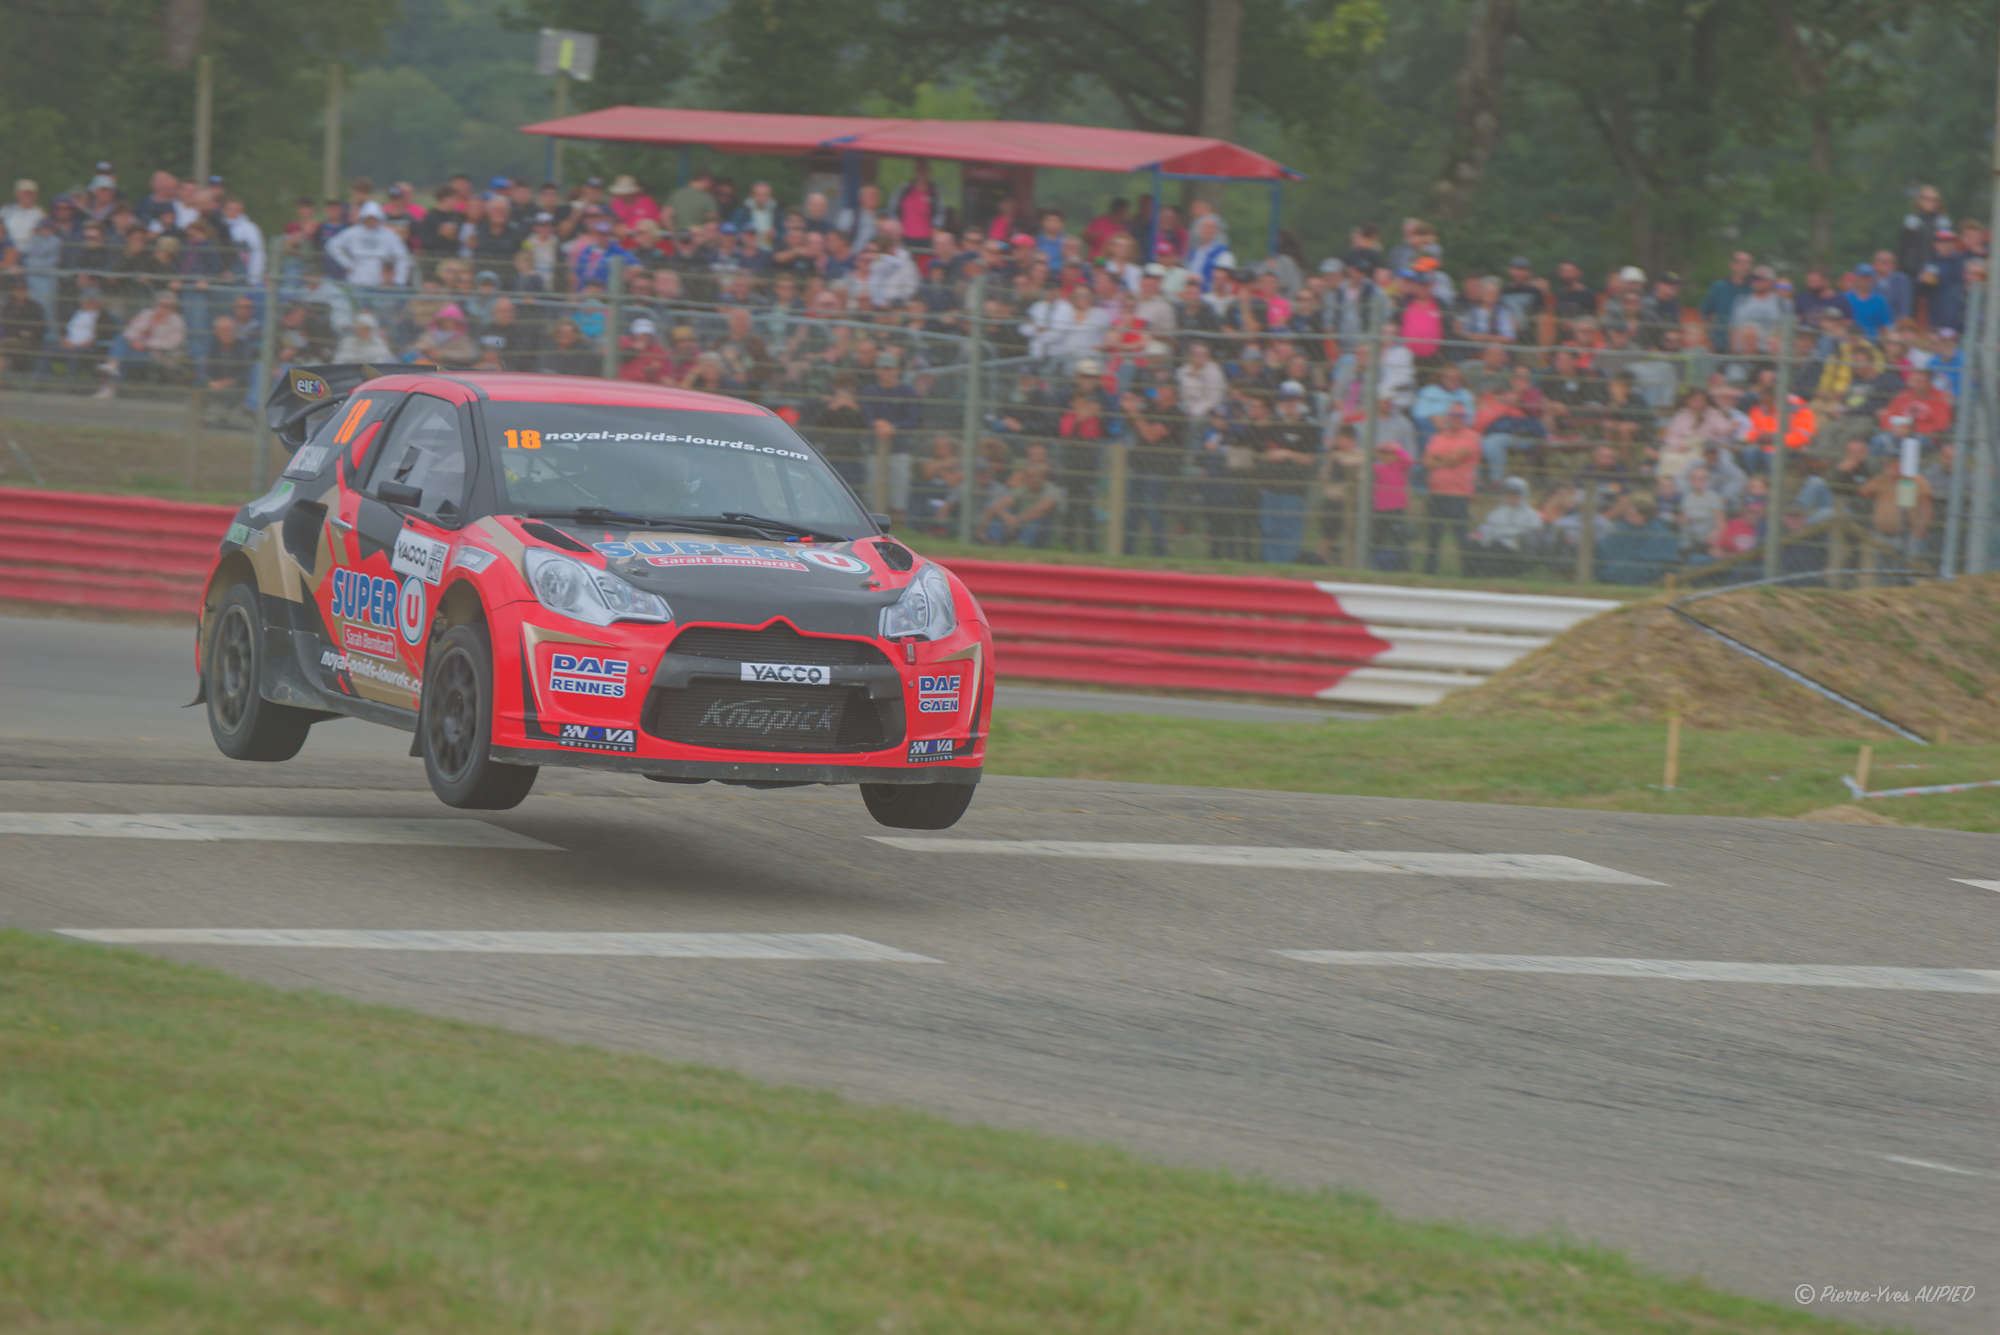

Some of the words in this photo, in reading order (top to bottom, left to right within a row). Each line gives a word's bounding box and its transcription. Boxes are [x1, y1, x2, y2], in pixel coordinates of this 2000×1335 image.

[297, 380, 314, 394] elf
[333, 399, 373, 445] 18
[503, 429, 543, 450] 18
[545, 431, 809, 461] noyal-poids-lourds.com
[398, 541, 428, 567] YACCO
[592, 541, 801, 562] SUPER
[658, 556, 703, 566] Sarah
[712, 557, 803, 570] Bernhardt
[332, 568, 398, 630] SUPER
[406, 593, 420, 629] U
[320, 650, 423, 695] noyal-poids-lourds.co
[553, 655, 628, 675] DAF
[749, 664, 823, 684] YACCO
[551, 678, 625, 697] RENNES
[919, 676, 961, 692] DAF
[919, 699, 959, 712] CAEN
[572, 725, 635, 743] NOVA
[918, 739, 953, 754] NOVA
